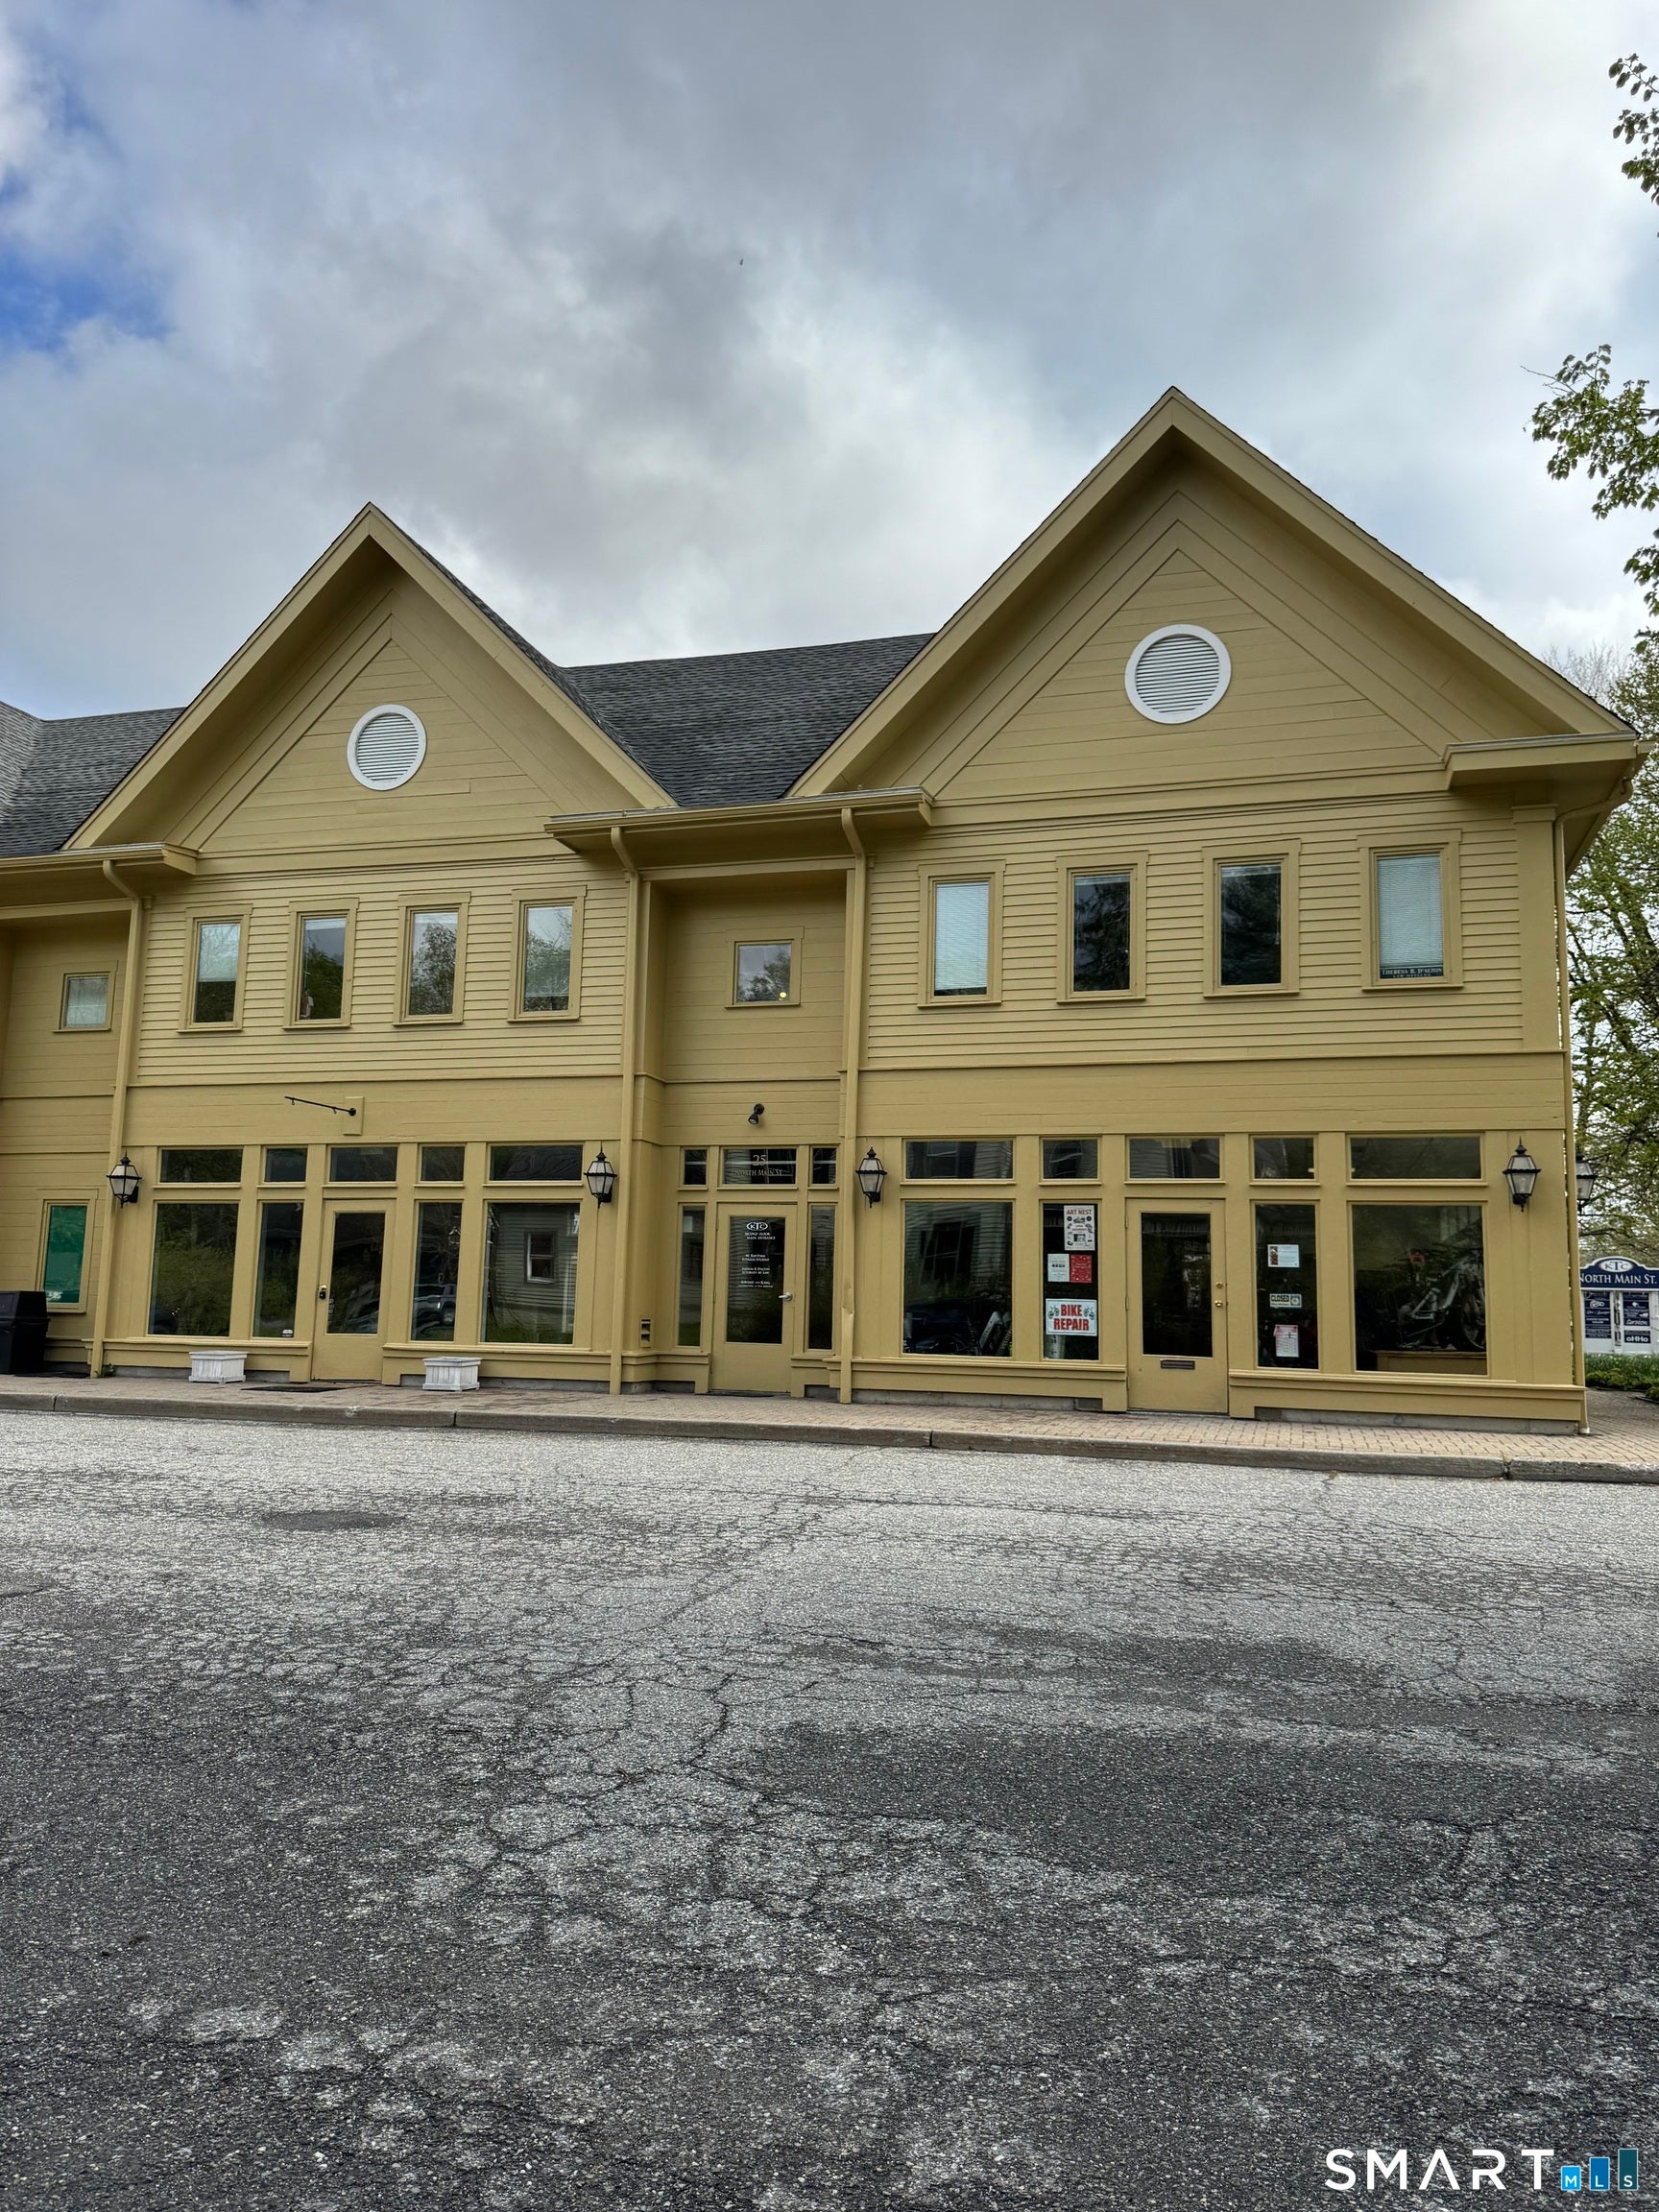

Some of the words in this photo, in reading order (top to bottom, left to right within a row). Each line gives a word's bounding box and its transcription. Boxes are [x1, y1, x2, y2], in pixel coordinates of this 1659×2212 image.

[753, 1154, 767, 1166] 25
[1604, 1262, 1629, 1270] KTC
[1615, 1274, 1642, 1284] MAIN
[1061, 1304, 1082, 1316] BIKE
[1053, 1318, 1090, 1331] REPAIR
